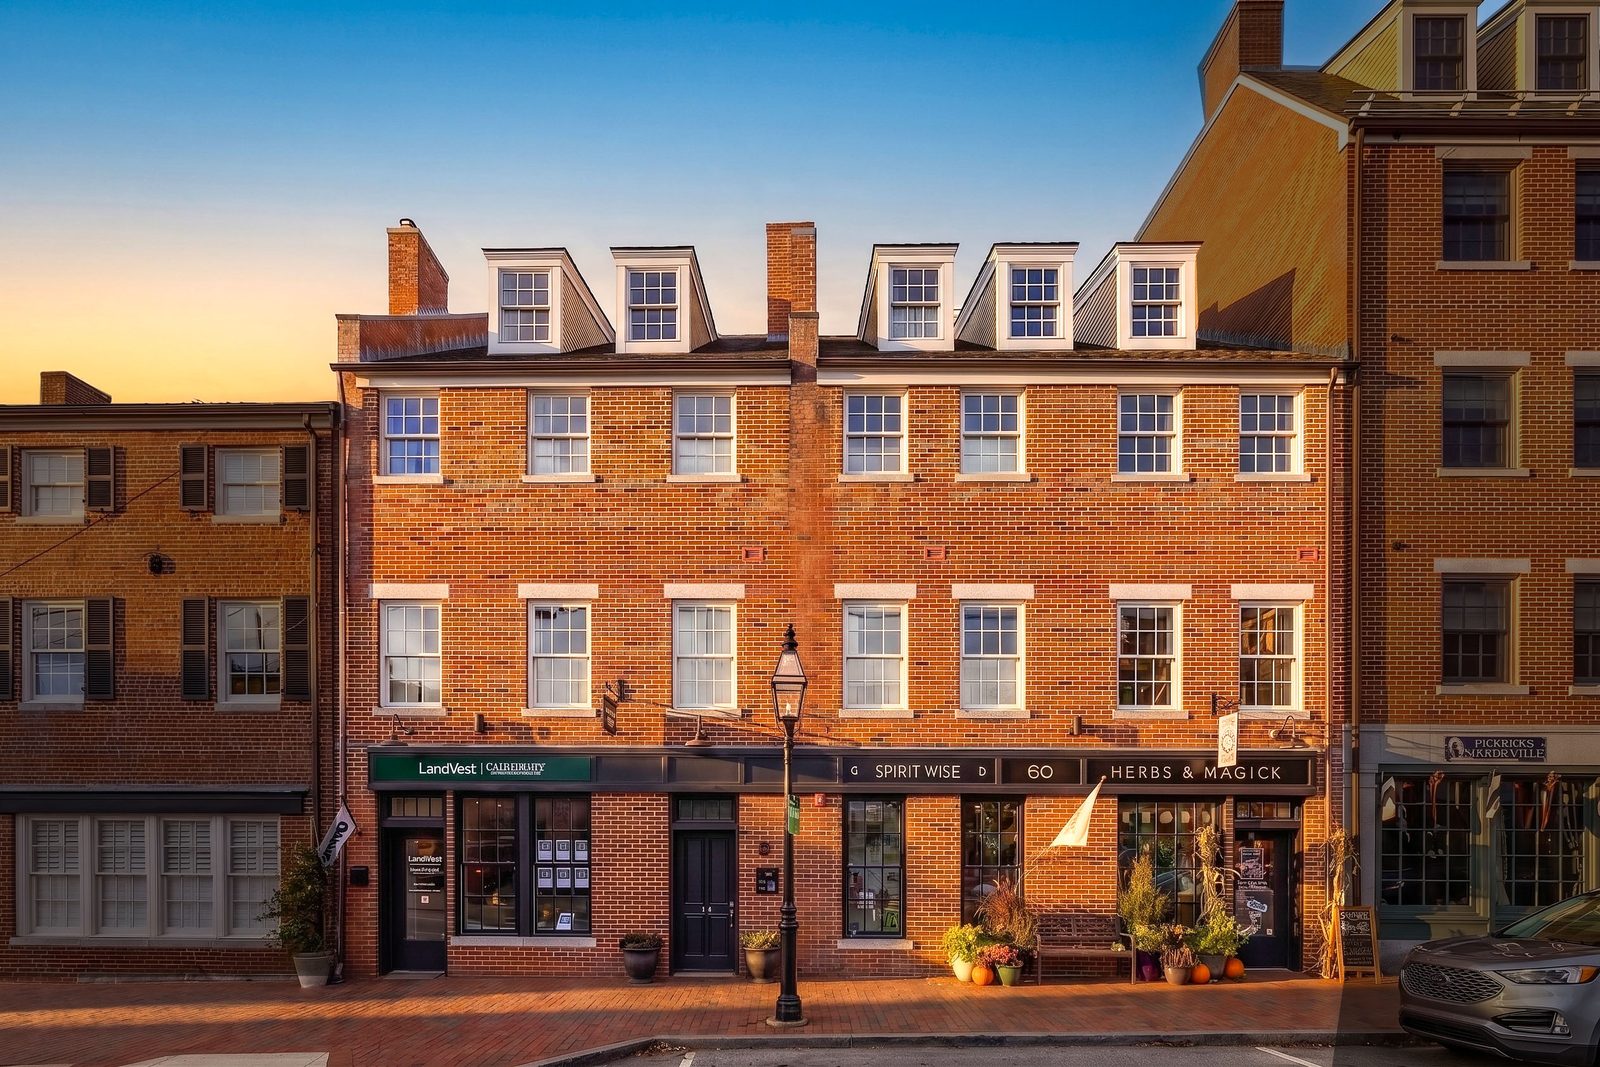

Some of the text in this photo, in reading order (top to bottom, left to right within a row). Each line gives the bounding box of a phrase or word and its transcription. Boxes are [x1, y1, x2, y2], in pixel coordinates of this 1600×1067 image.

[1475, 739, 1535, 748] PICKRICKS
[419, 762, 477, 775] LandVest
[850, 764, 987, 779] G SPIRIT WISE D
[1027, 764, 1054, 780] 60
[1111, 765, 1281, 780] HERBS & MAGICK
